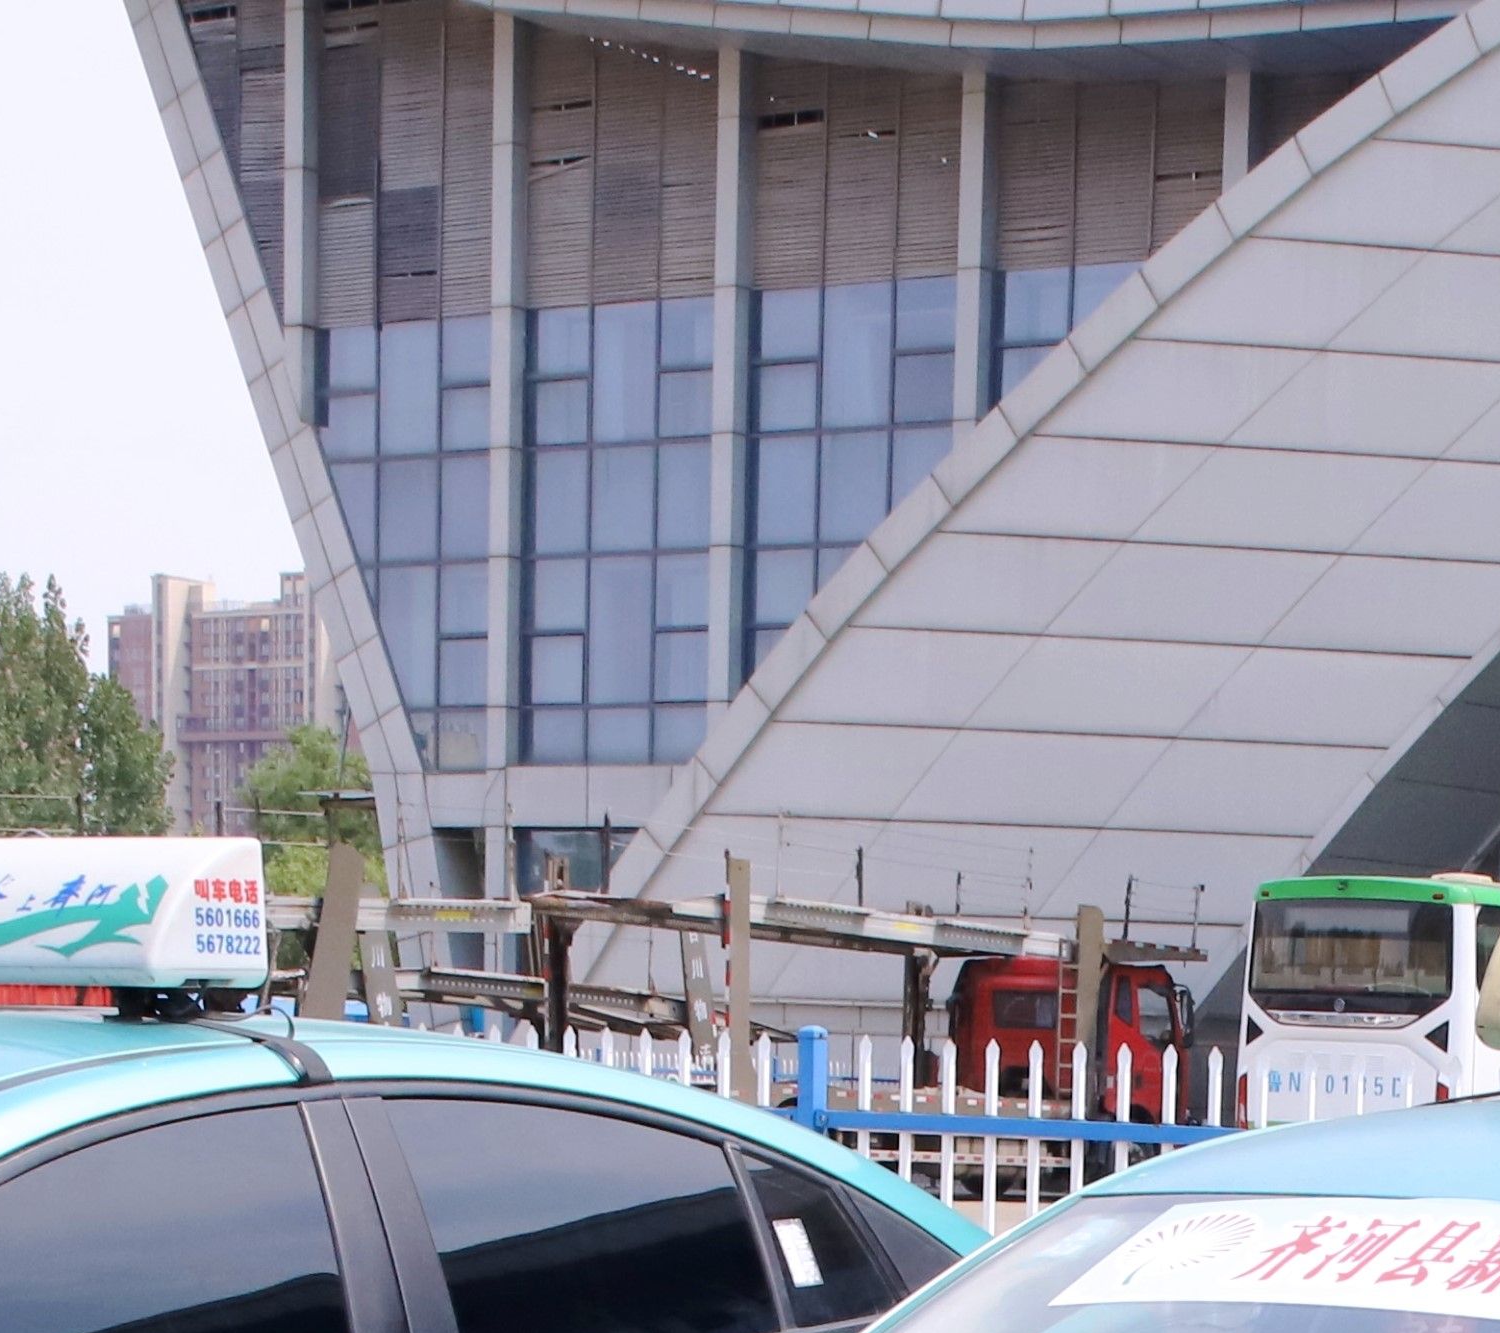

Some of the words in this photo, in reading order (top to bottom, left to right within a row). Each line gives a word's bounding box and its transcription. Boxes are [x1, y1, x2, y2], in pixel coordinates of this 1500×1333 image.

[193, 878, 259, 904] 叫车电话
[195, 907, 261, 930] 5601666
[196, 934, 261, 955] 5678222
